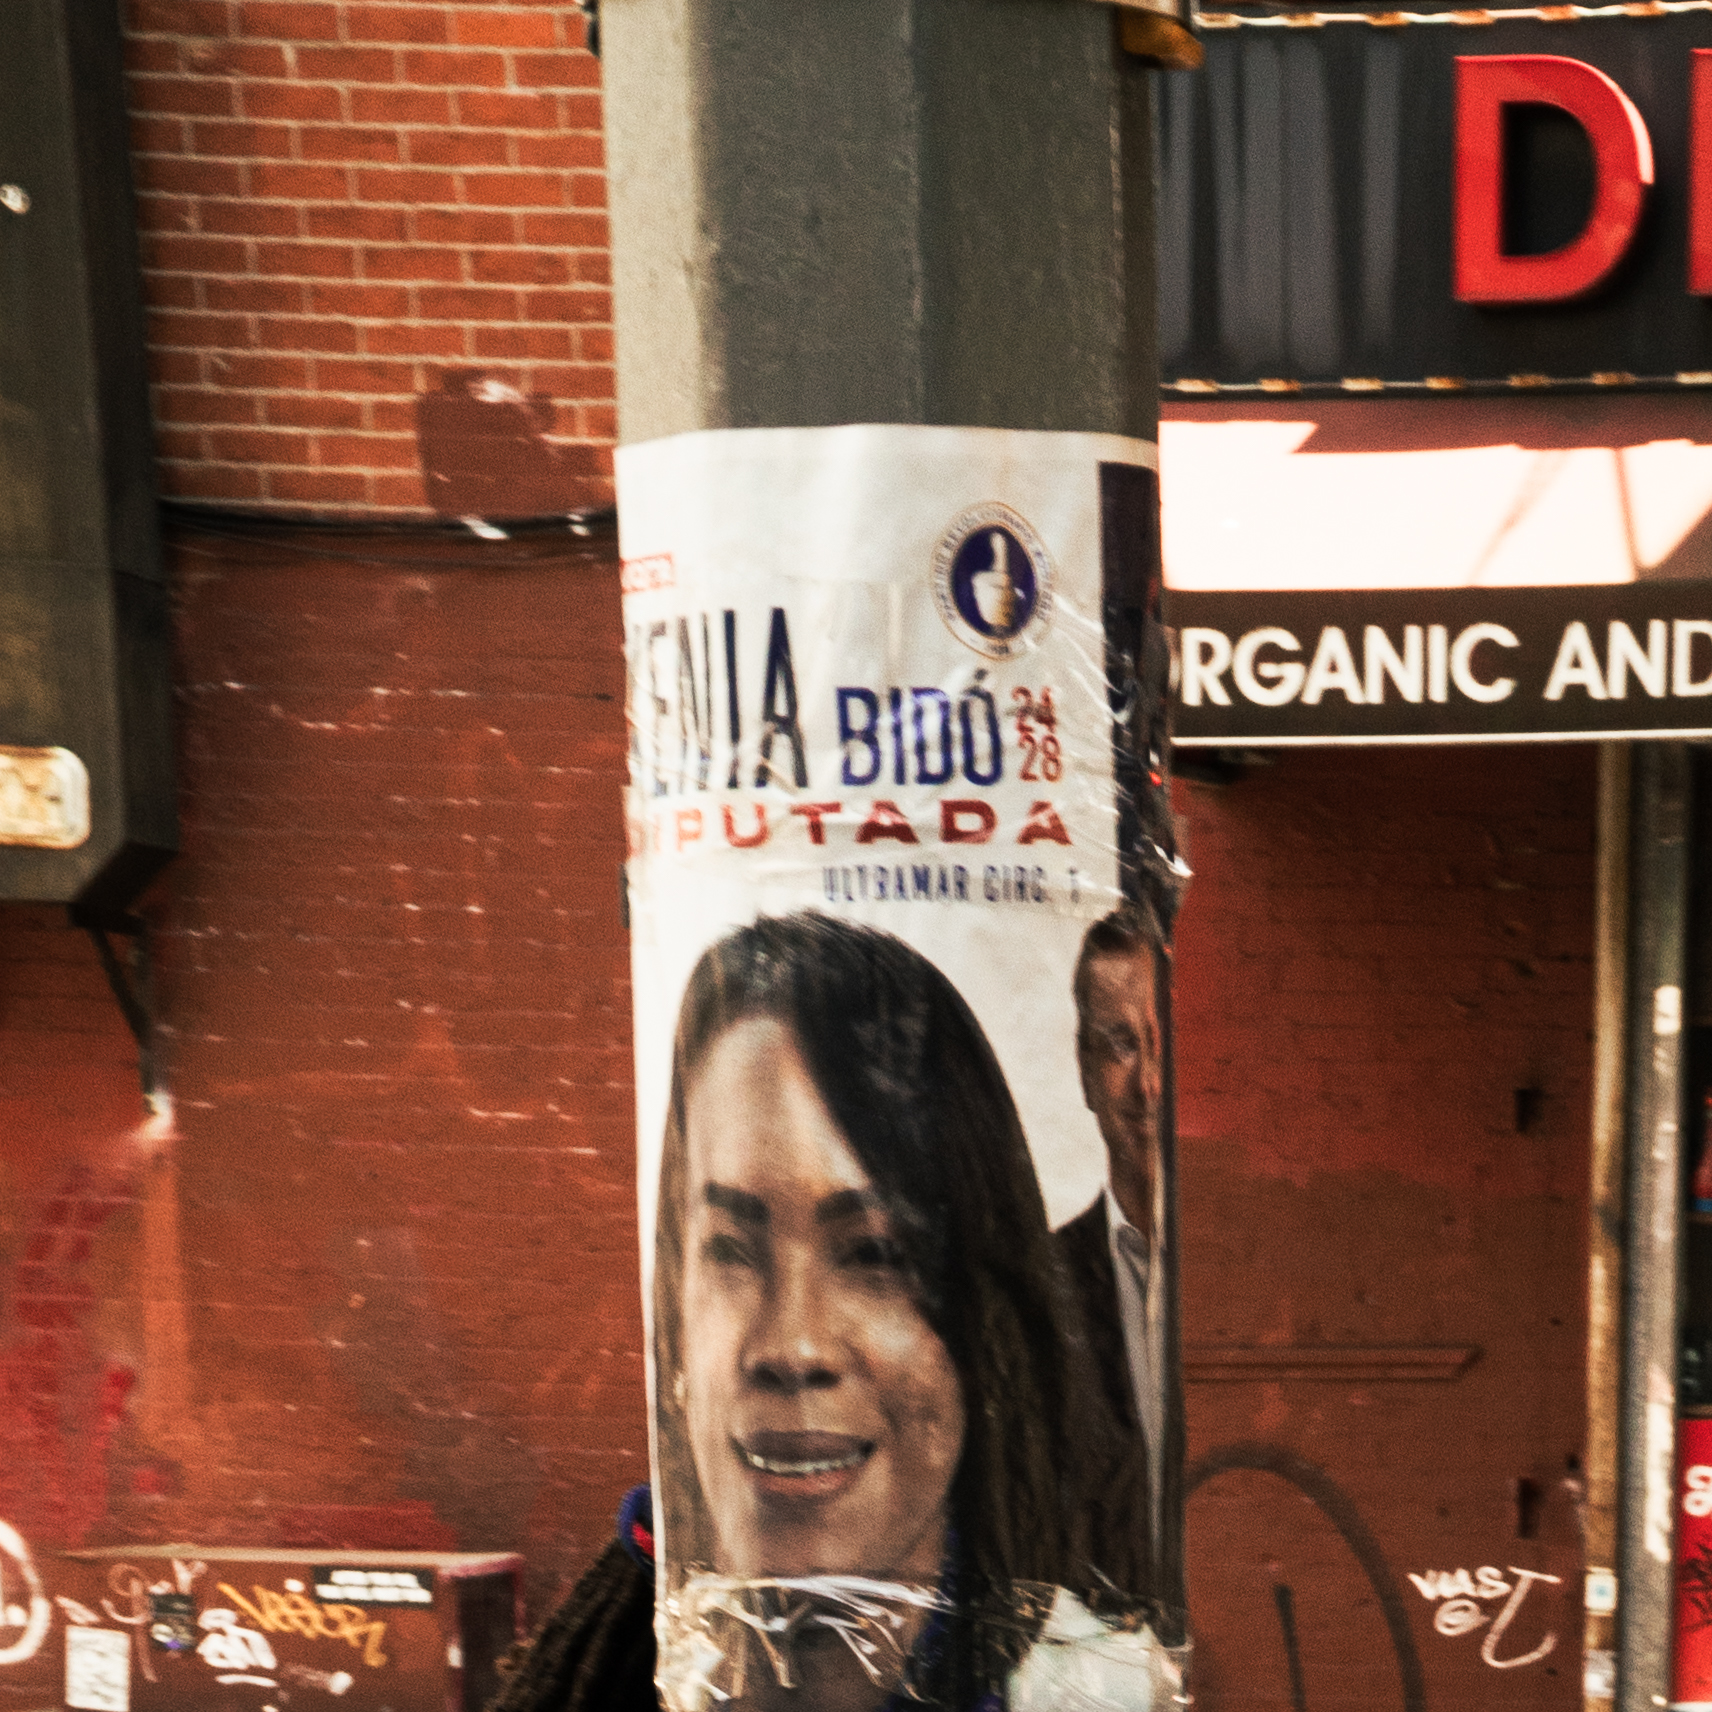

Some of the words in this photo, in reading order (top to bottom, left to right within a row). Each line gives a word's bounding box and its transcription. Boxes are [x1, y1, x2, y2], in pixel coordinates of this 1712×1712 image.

[624, 606, 810, 799] ENIA
[1166, 622, 1518, 708] RGANIC
[835, 667, 1004, 788] BIDÓ
[1018, 733, 1063, 783] 28
[822, 862, 970, 902] ULTRAMAR
